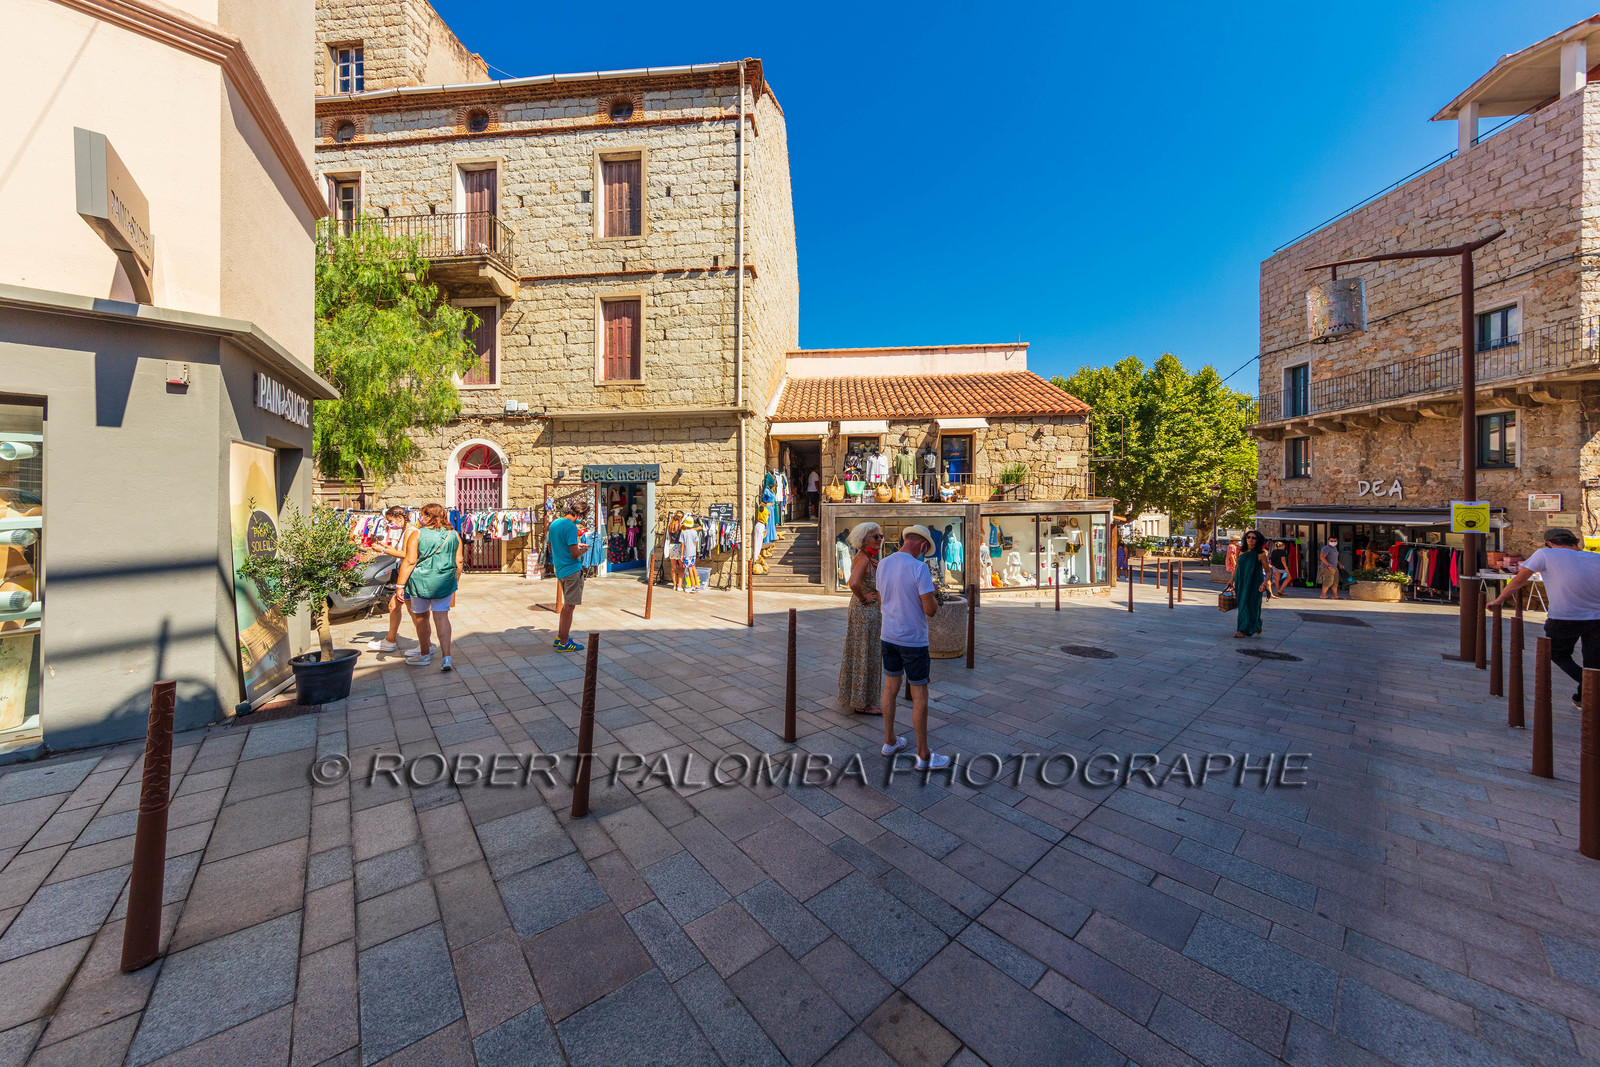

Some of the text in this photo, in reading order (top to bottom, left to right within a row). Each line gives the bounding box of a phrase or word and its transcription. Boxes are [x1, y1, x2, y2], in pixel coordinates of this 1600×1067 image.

[257, 373, 281, 416] PAIN
[286, 389, 309, 428] SUCRE
[583, 466, 658, 481] Bleu & marine
[1358, 479, 1403, 500] DEA
